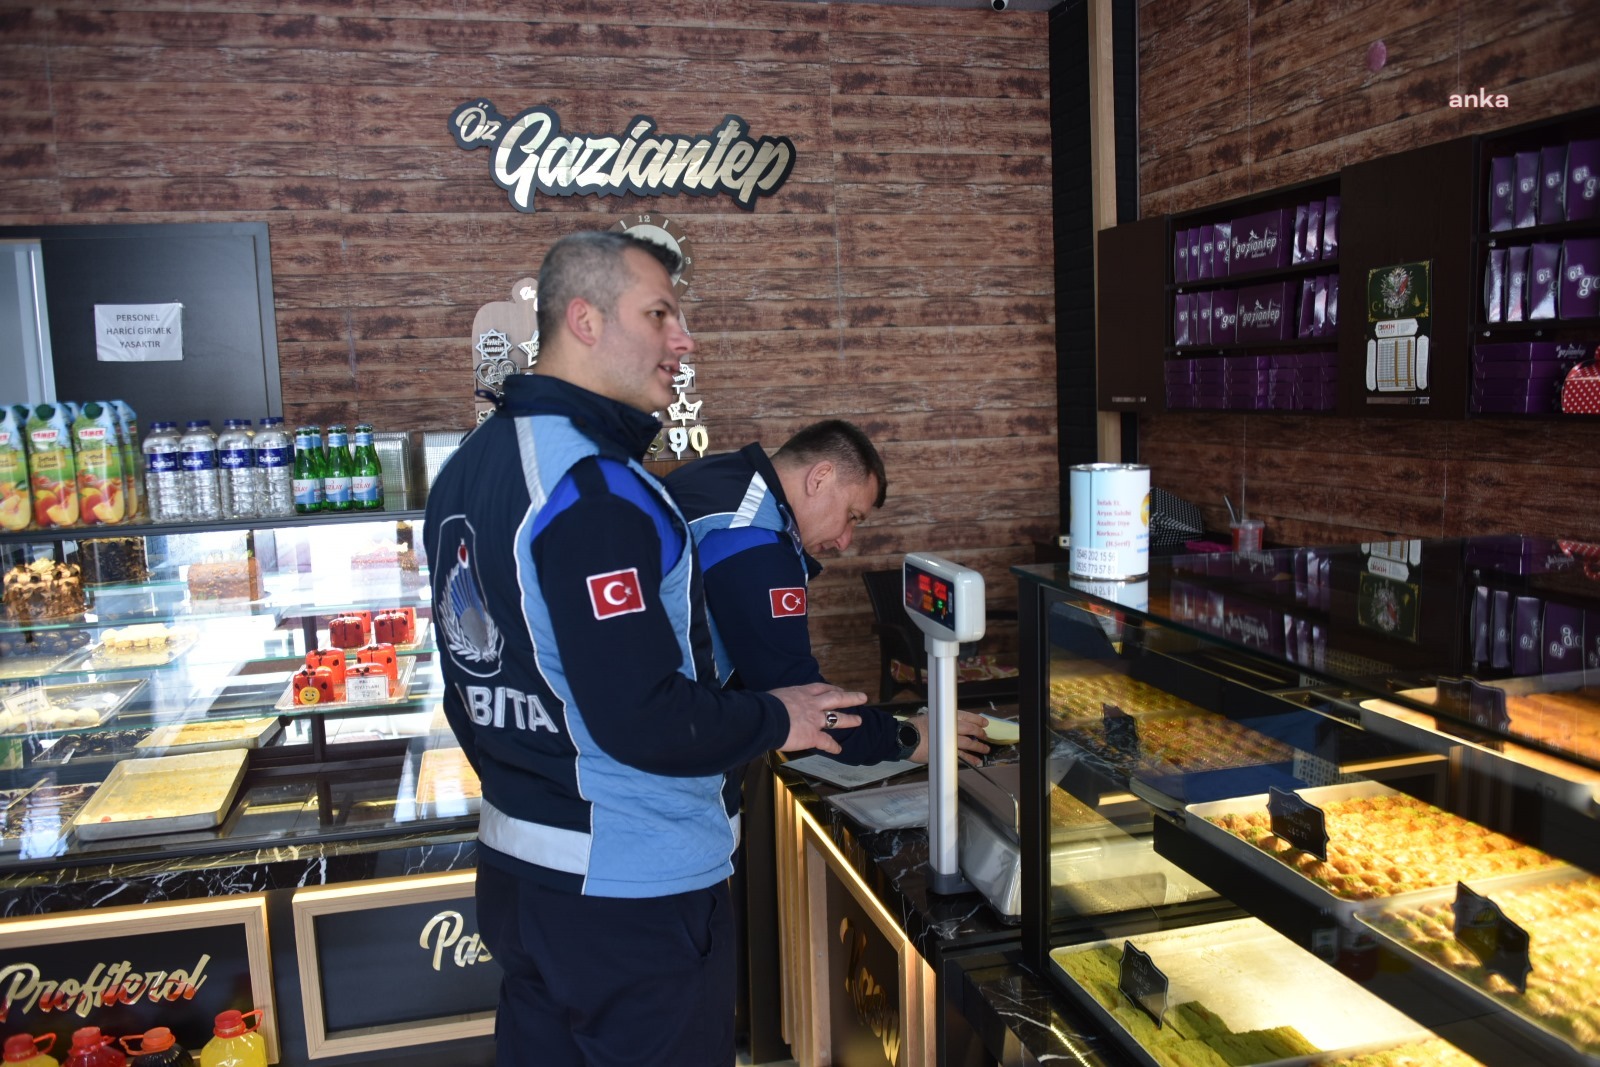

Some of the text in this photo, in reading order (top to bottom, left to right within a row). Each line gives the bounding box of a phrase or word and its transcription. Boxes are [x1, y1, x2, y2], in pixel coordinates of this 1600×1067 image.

[455, 102, 790, 207] Öz Gaziantep
[638, 215, 651, 223] 12
[684, 256, 692, 265] 3
[116, 314, 160, 322] PERSONEL
[106, 326, 172, 335] HARİCİ GİRMEK
[119, 340, 161, 348] YASAKTIR
[455, 683, 559, 733] BITA
[419, 910, 493, 971] Pas
[0, 953, 211, 1023] Profiterol
